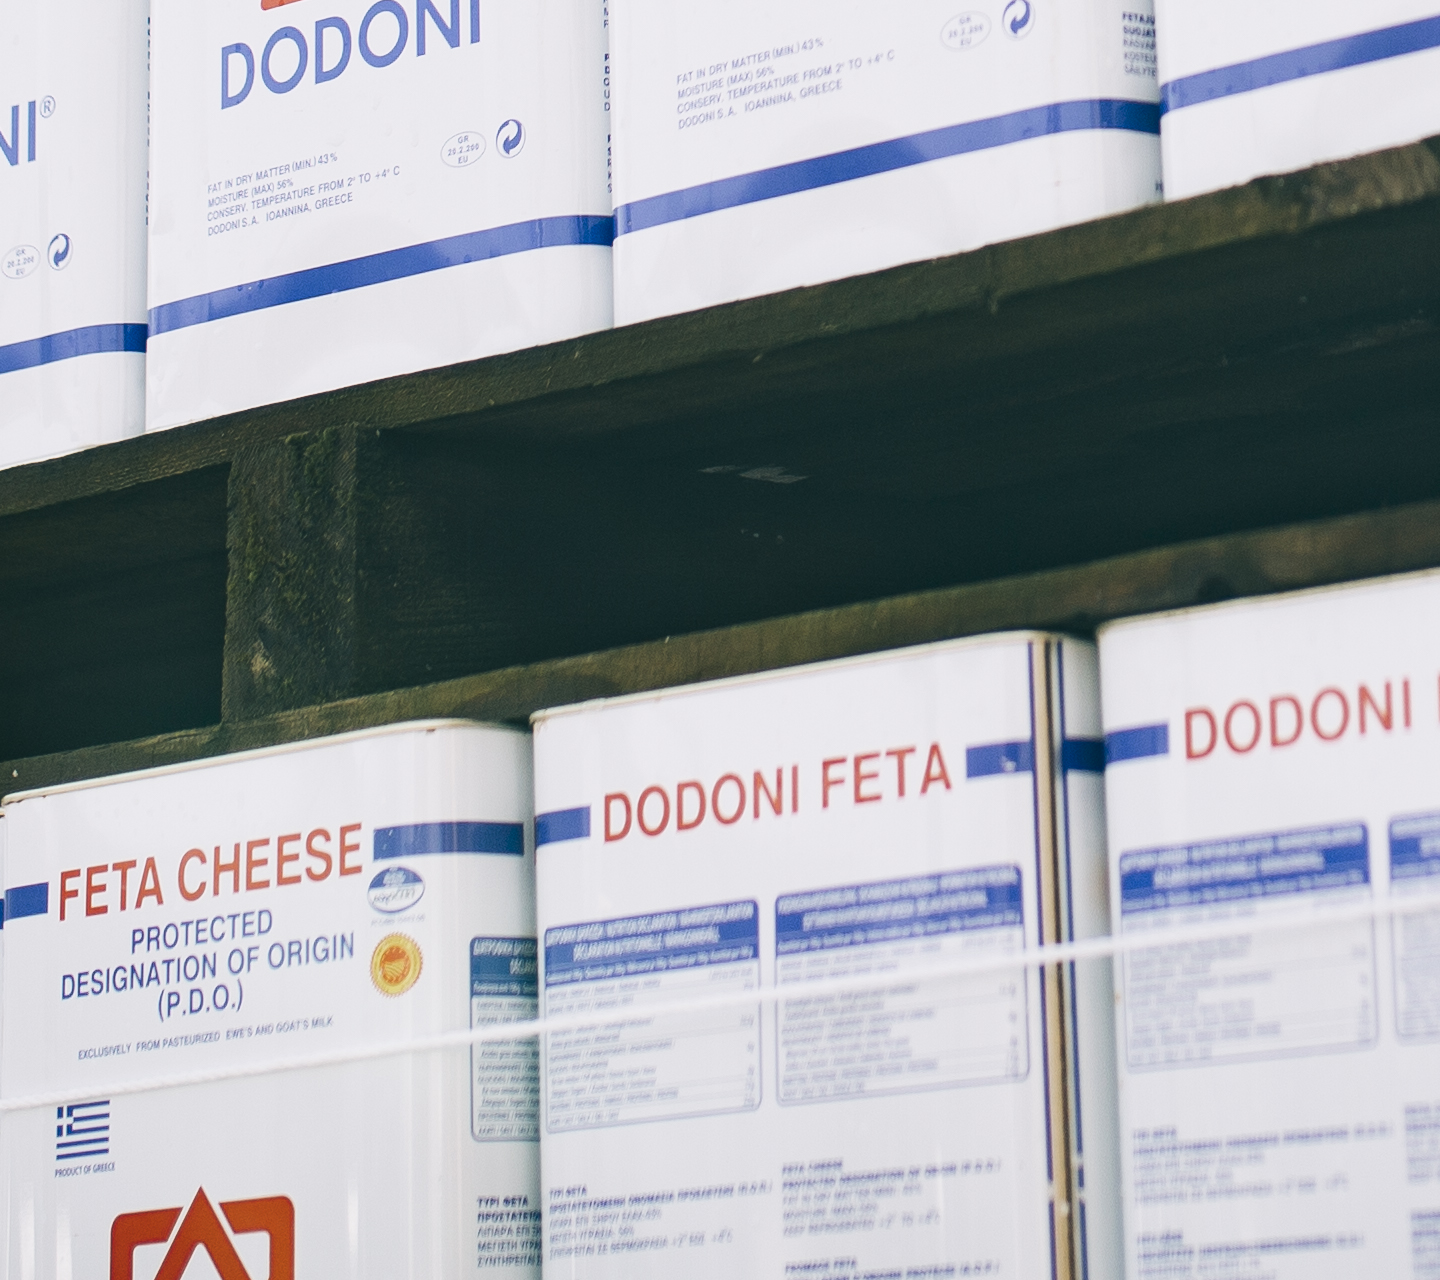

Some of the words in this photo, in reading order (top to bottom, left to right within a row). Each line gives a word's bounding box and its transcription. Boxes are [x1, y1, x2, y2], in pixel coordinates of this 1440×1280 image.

[1184, 677, 1411, 762] DODONI
[604, 764, 798, 844] DODONI
[822, 742, 952, 810] FETA
[59, 856, 163, 922] FETA
[178, 822, 362, 902] CHEESE
[62, 953, 216, 1001] DESIGNATION
[228, 946, 258, 975] OF
[268, 933, 353, 969] ORIGIN
[132, 909, 272, 954] PROTECTED
[158, 979, 243, 1022] (P.D.O.)
